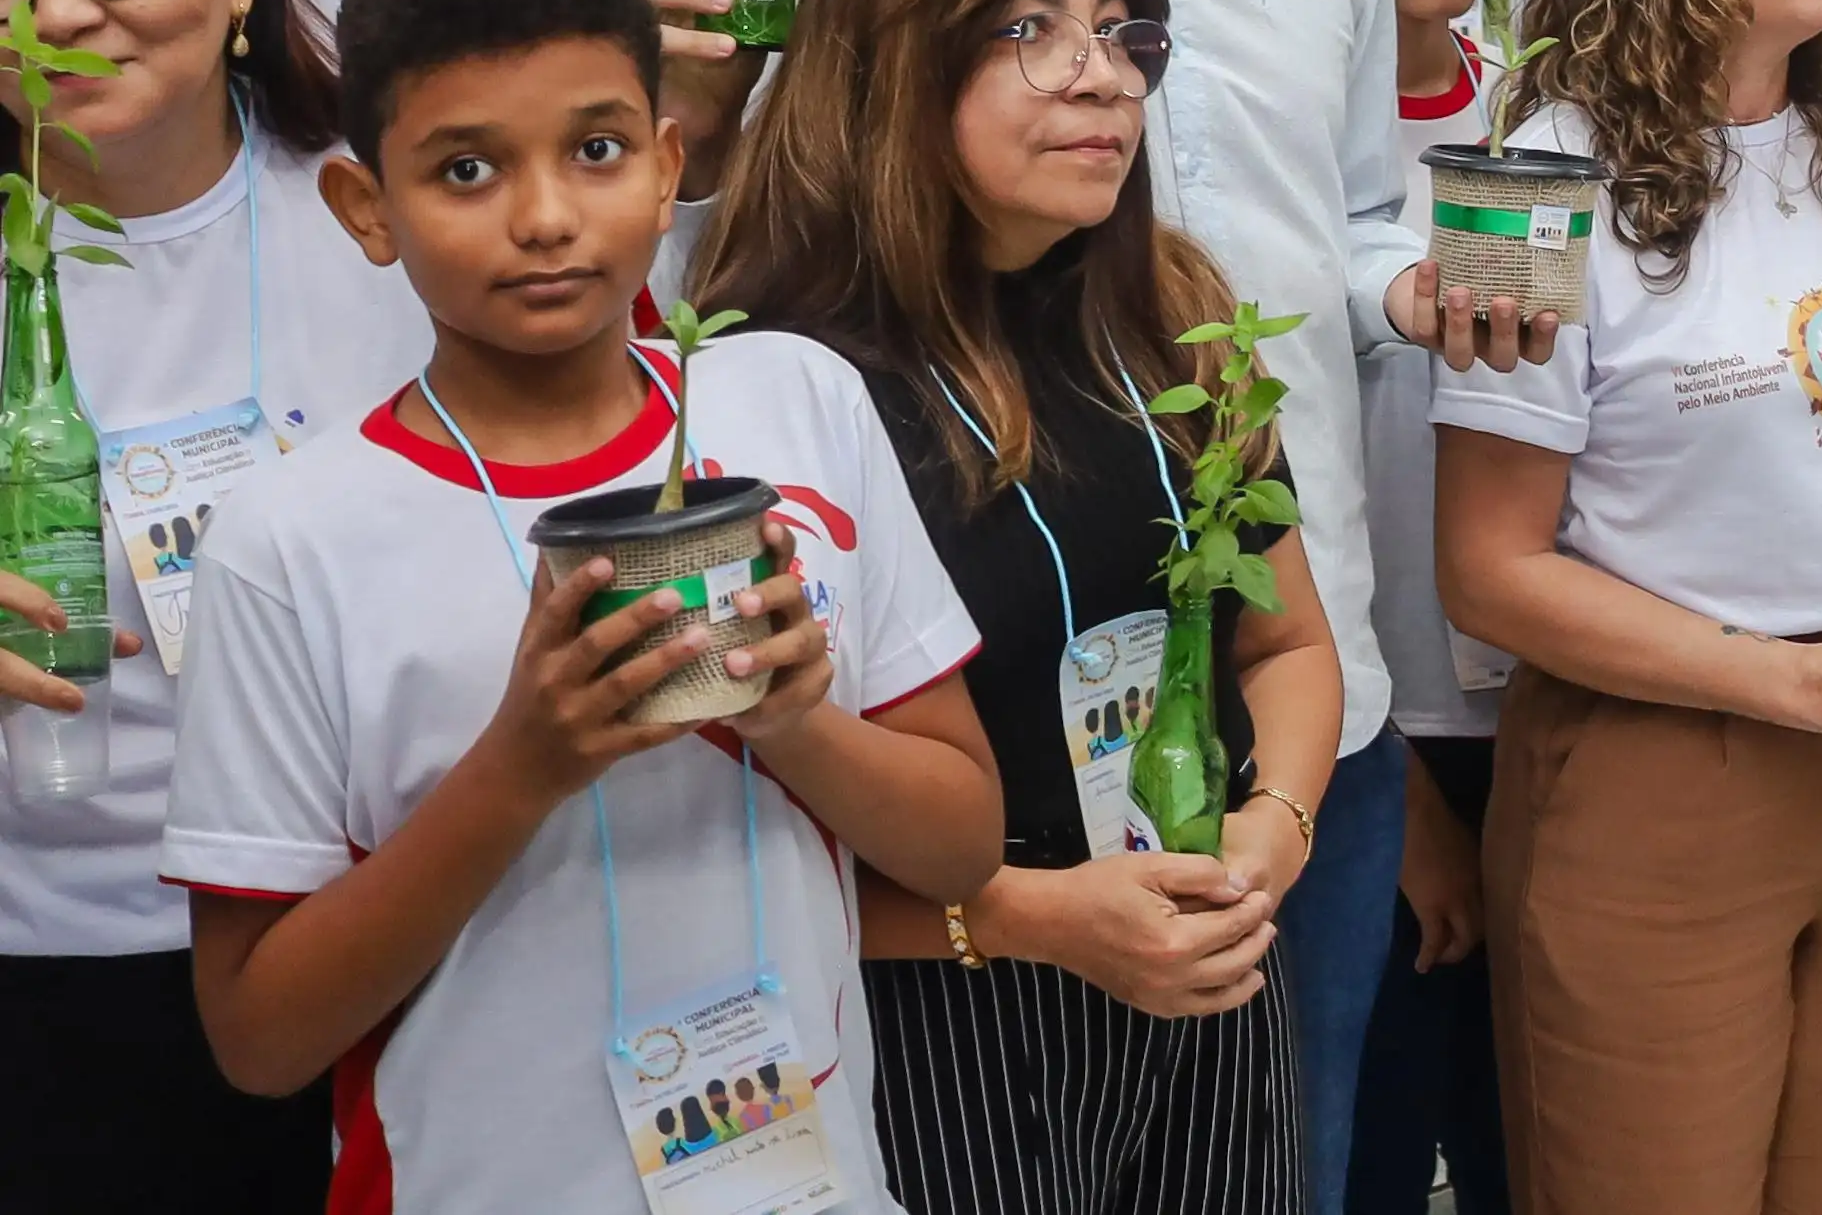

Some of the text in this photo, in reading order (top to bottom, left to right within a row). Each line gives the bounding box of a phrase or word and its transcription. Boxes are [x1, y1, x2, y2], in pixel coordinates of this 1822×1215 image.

[1674, 360, 1789, 394] Nacional Infantojuvenil
[1684, 354, 1746, 376] Conferência
[1677, 380, 1781, 414] pelo Meio Ambiente
[181, 436, 241, 459] MUNICIPAL
[684, 987, 761, 1025] CONFERÊNCIA
[696, 1003, 756, 1033] MUNICIPAL
